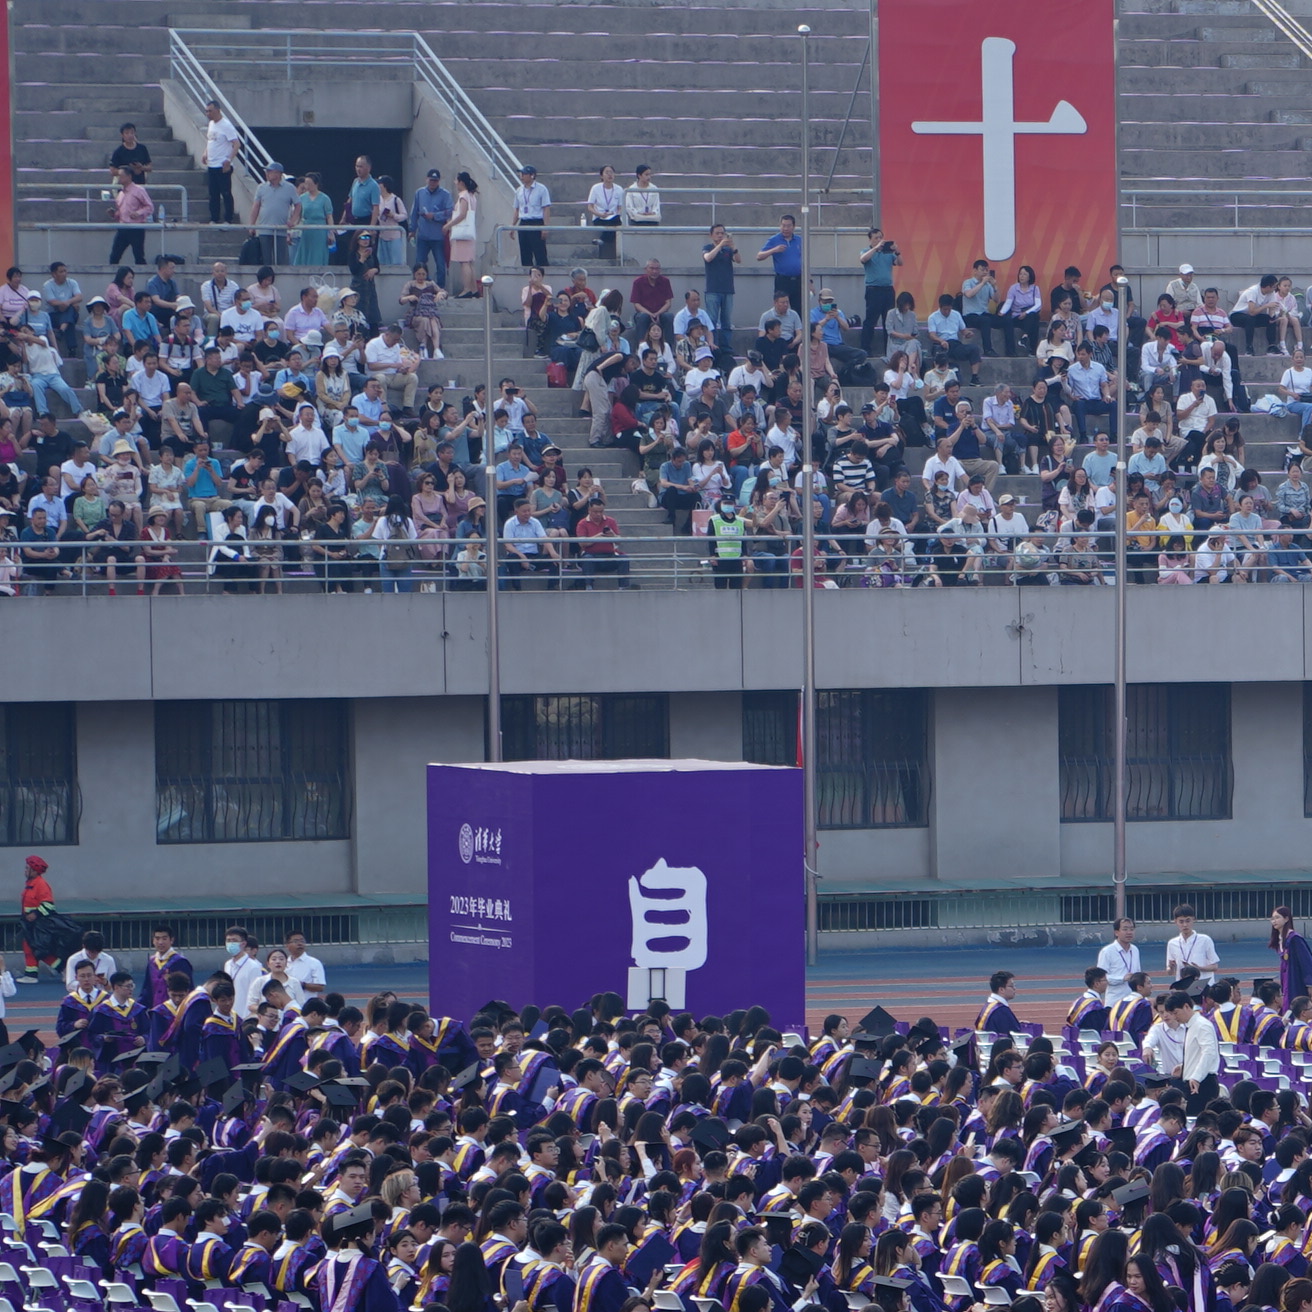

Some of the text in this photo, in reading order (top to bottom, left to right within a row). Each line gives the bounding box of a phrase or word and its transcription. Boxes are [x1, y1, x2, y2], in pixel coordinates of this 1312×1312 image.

[911, 36, 1088, 261] 十
[450, 895, 512, 921] 2023年毕业典礼
